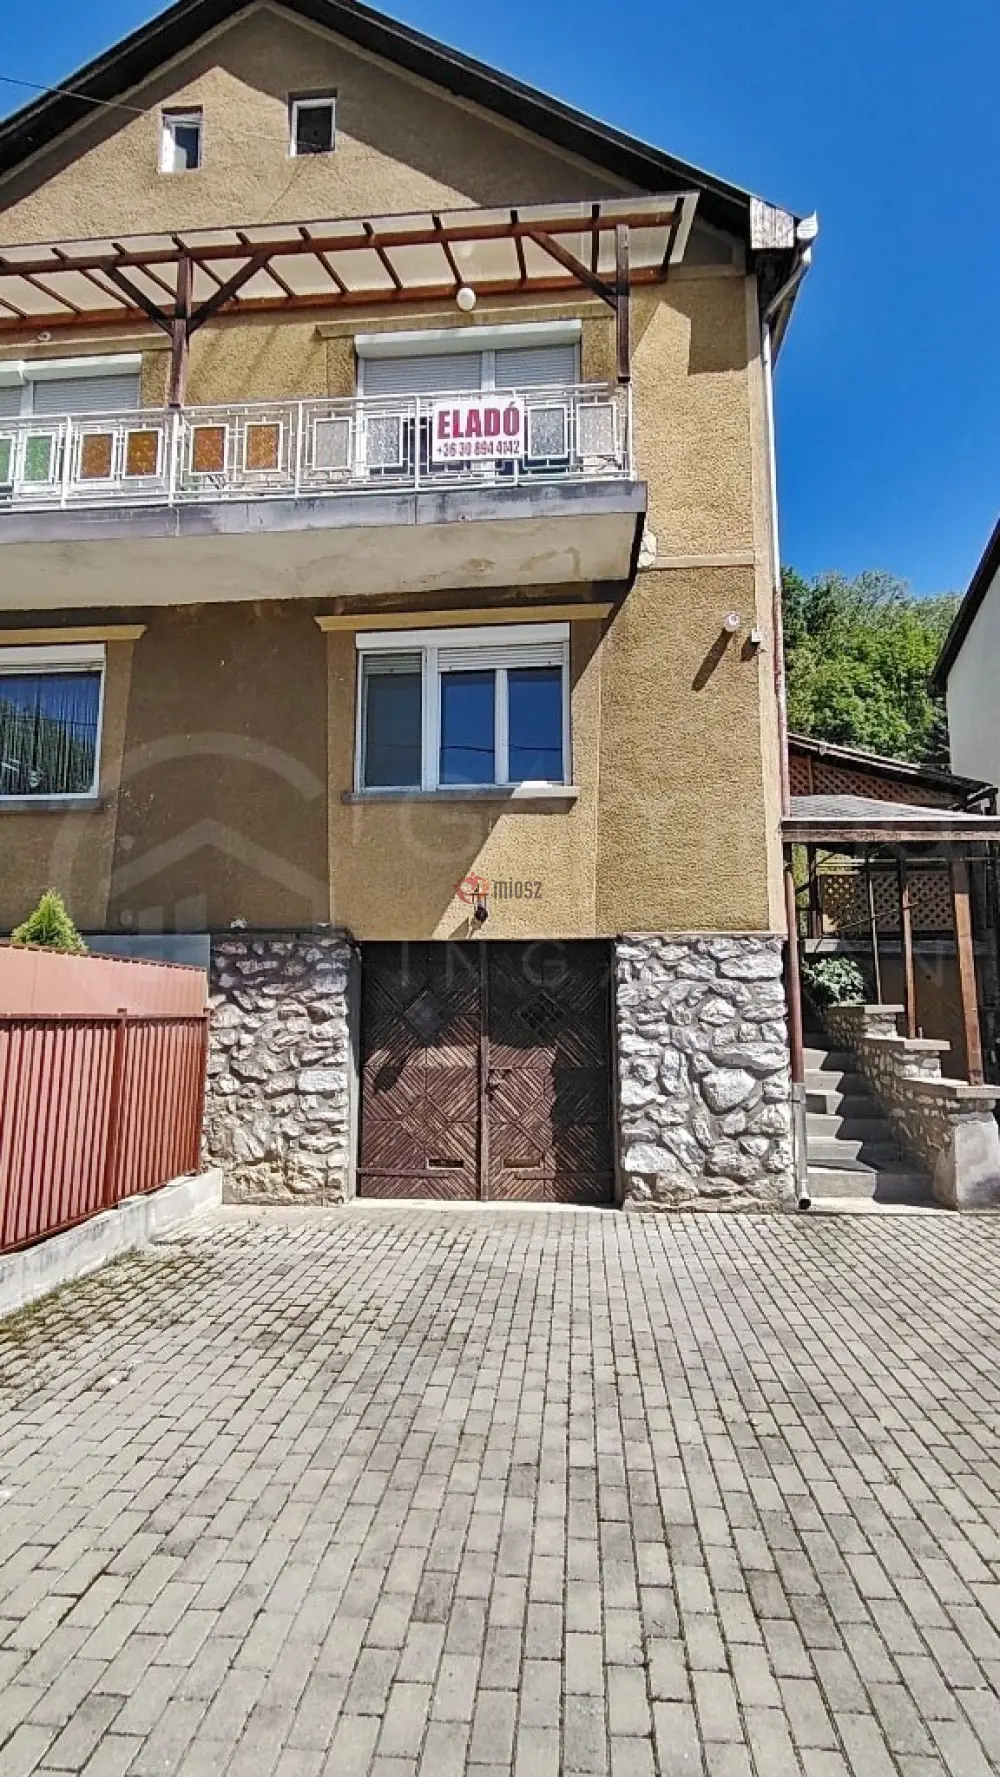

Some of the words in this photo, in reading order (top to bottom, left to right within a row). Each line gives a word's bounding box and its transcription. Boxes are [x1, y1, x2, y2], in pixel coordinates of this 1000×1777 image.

[437, 401, 520, 439] ELADÓ
[436, 441, 457, 457] +36
[459, 441, 472, 457] 30
[496, 440, 520, 454] 4142
